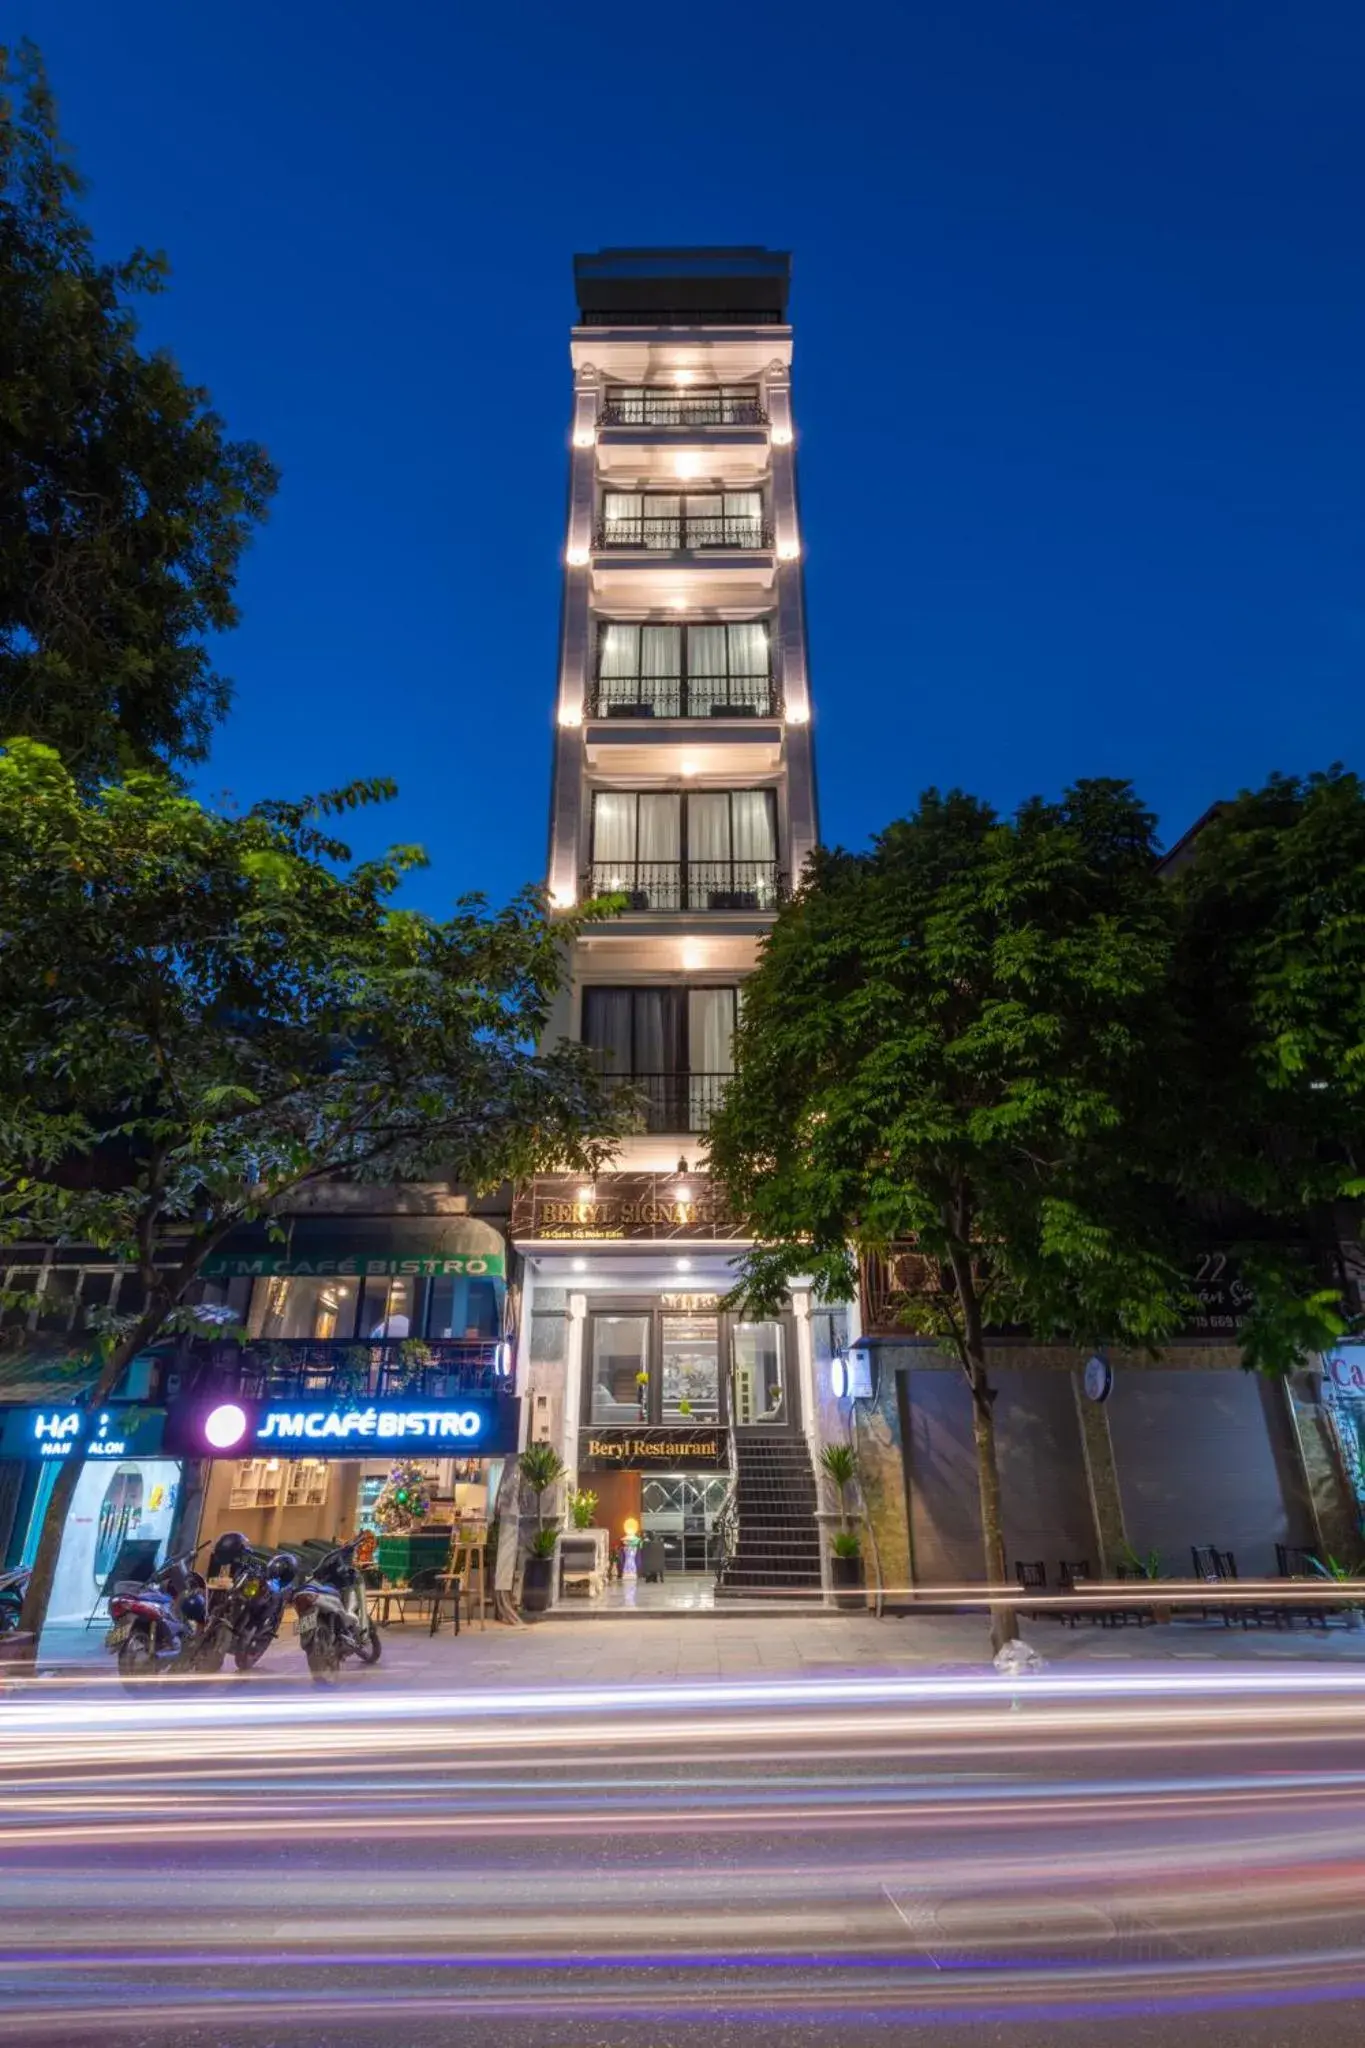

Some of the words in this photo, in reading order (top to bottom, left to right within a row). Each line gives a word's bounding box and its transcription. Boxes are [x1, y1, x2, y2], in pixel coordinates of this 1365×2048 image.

[542, 1203, 615, 1224] BERYL
[273, 1257, 356, 1274] CAFÉ
[366, 1260, 488, 1274] BISTRO
[1193, 1252, 1227, 1282] 22
[377, 1411, 481, 1437] BISTRO
[87, 1442, 125, 1454] ALON
[588, 1439, 629, 1459] Beryl
[634, 1439, 717, 1456] Restaurant
